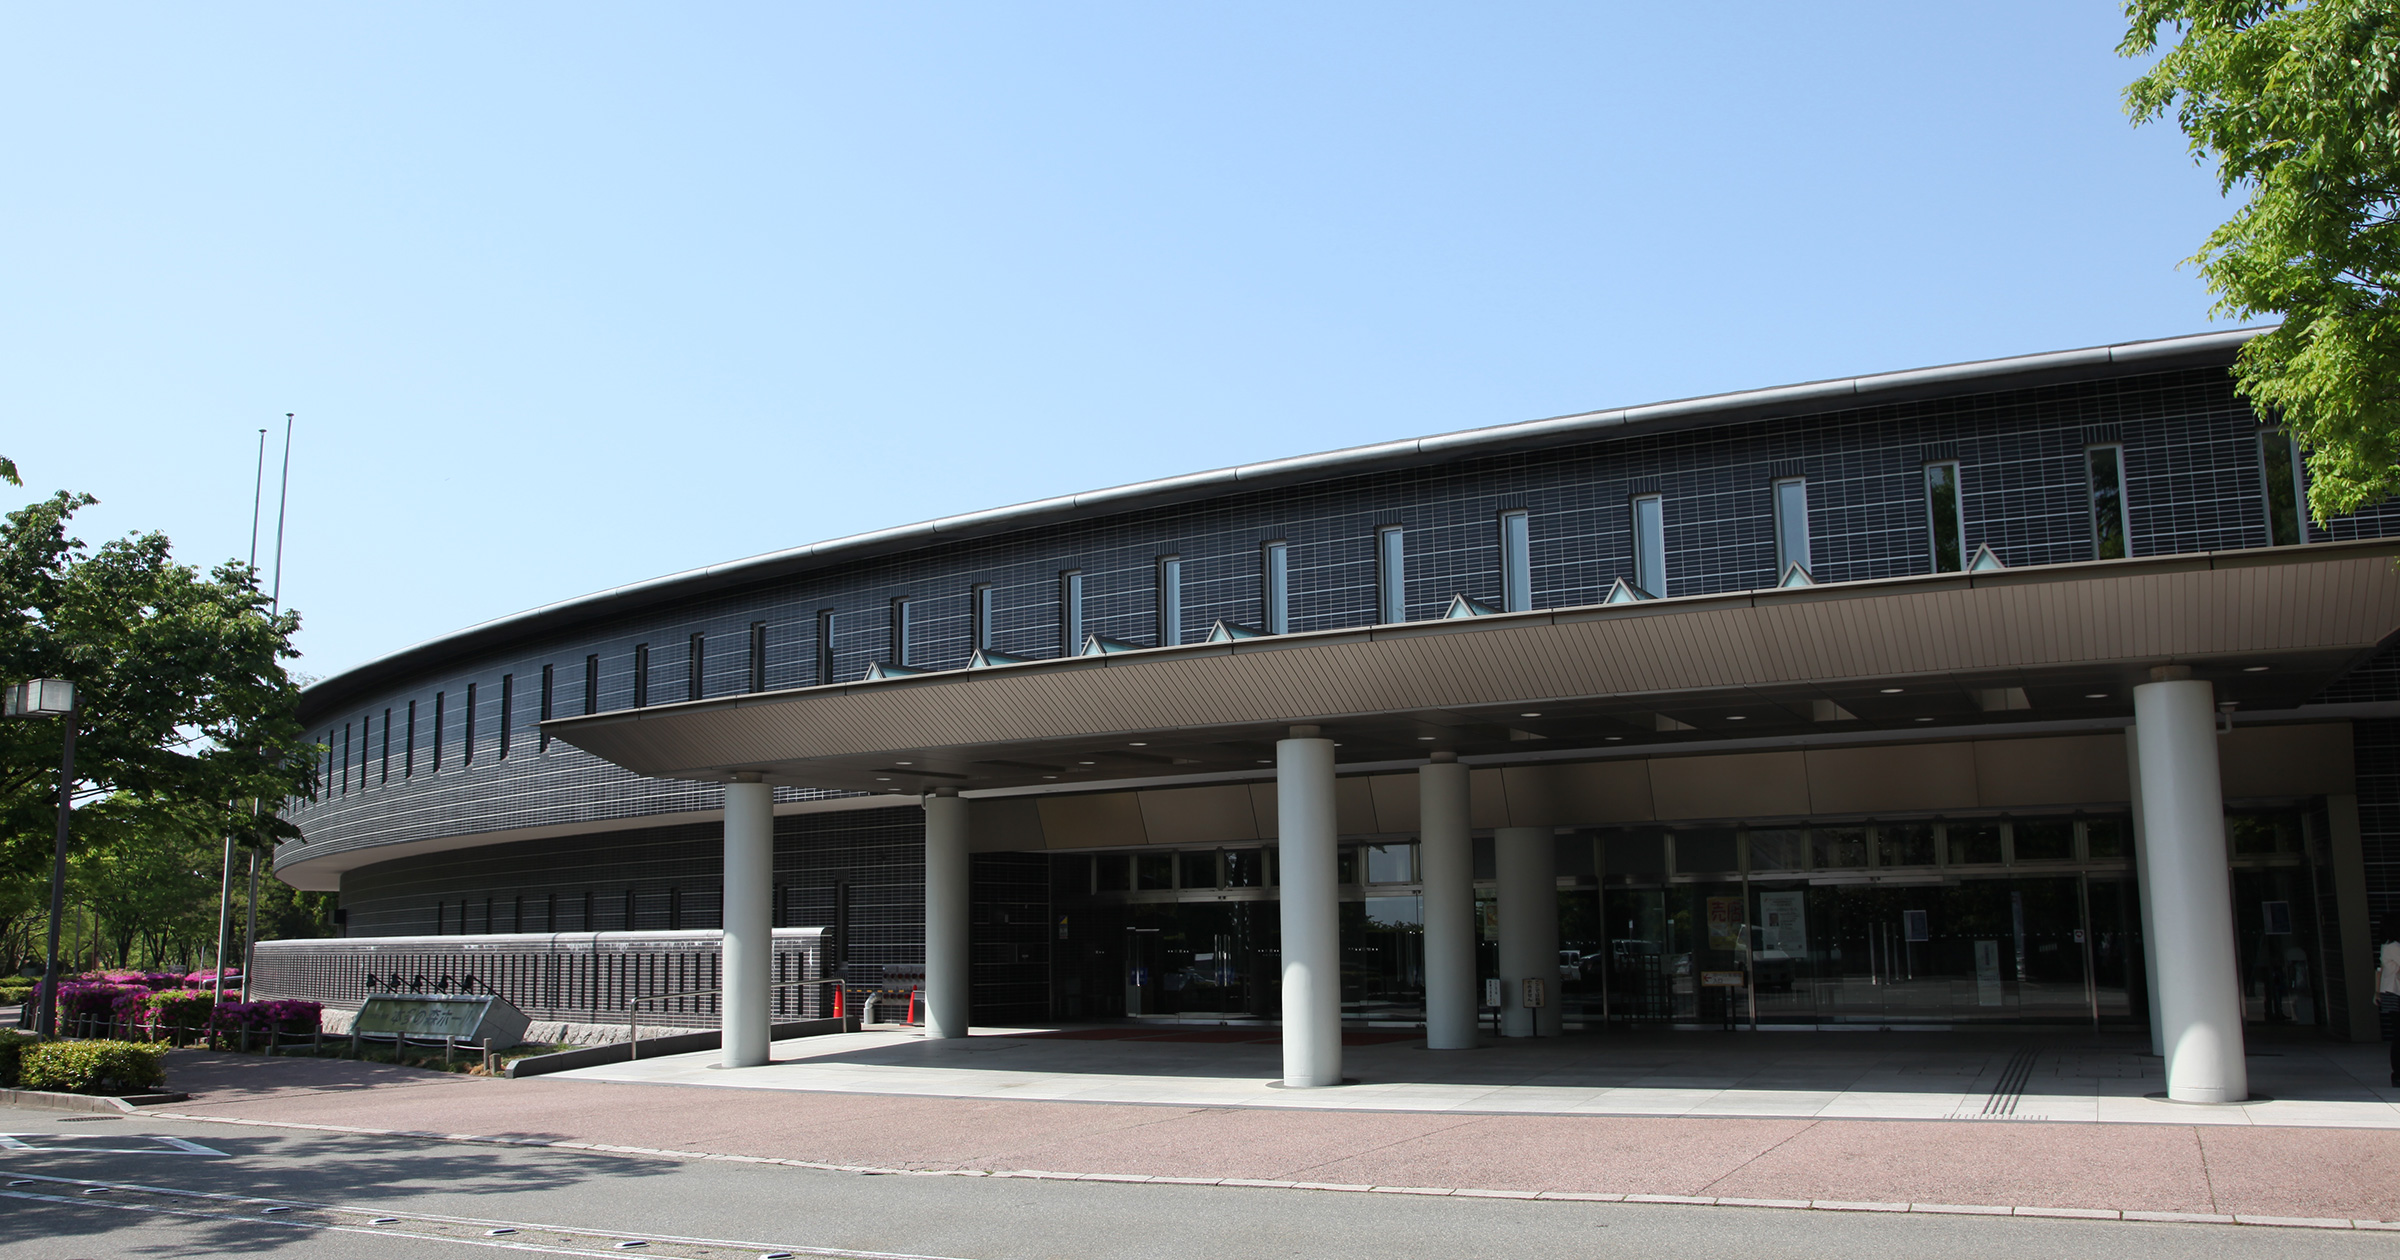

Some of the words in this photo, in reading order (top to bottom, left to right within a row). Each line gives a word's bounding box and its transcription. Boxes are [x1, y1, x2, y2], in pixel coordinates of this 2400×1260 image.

[1712, 901, 1744, 922] 売店
[391, 1008, 473, 1026] 本多の森ホール
